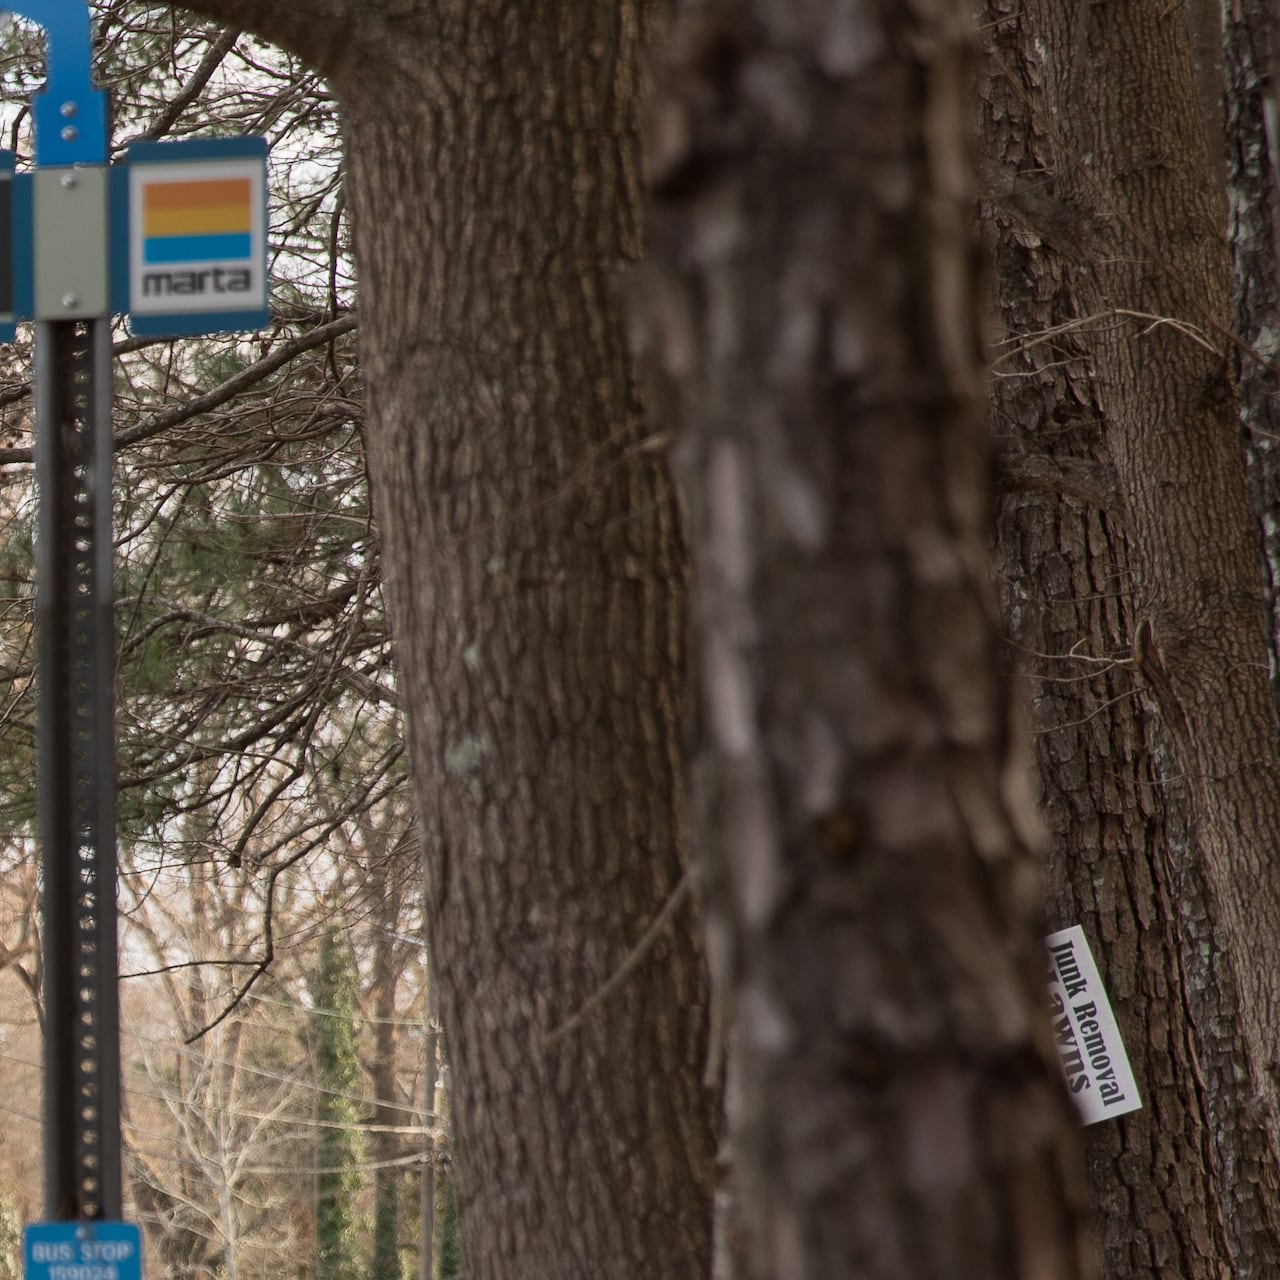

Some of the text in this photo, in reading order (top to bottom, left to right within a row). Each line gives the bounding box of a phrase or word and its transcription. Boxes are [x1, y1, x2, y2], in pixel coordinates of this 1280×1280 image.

[142, 266, 251, 297] marta
[1048, 940, 1126, 1107] Junk Removal
[32, 1239, 131, 1263] BUS STOP
